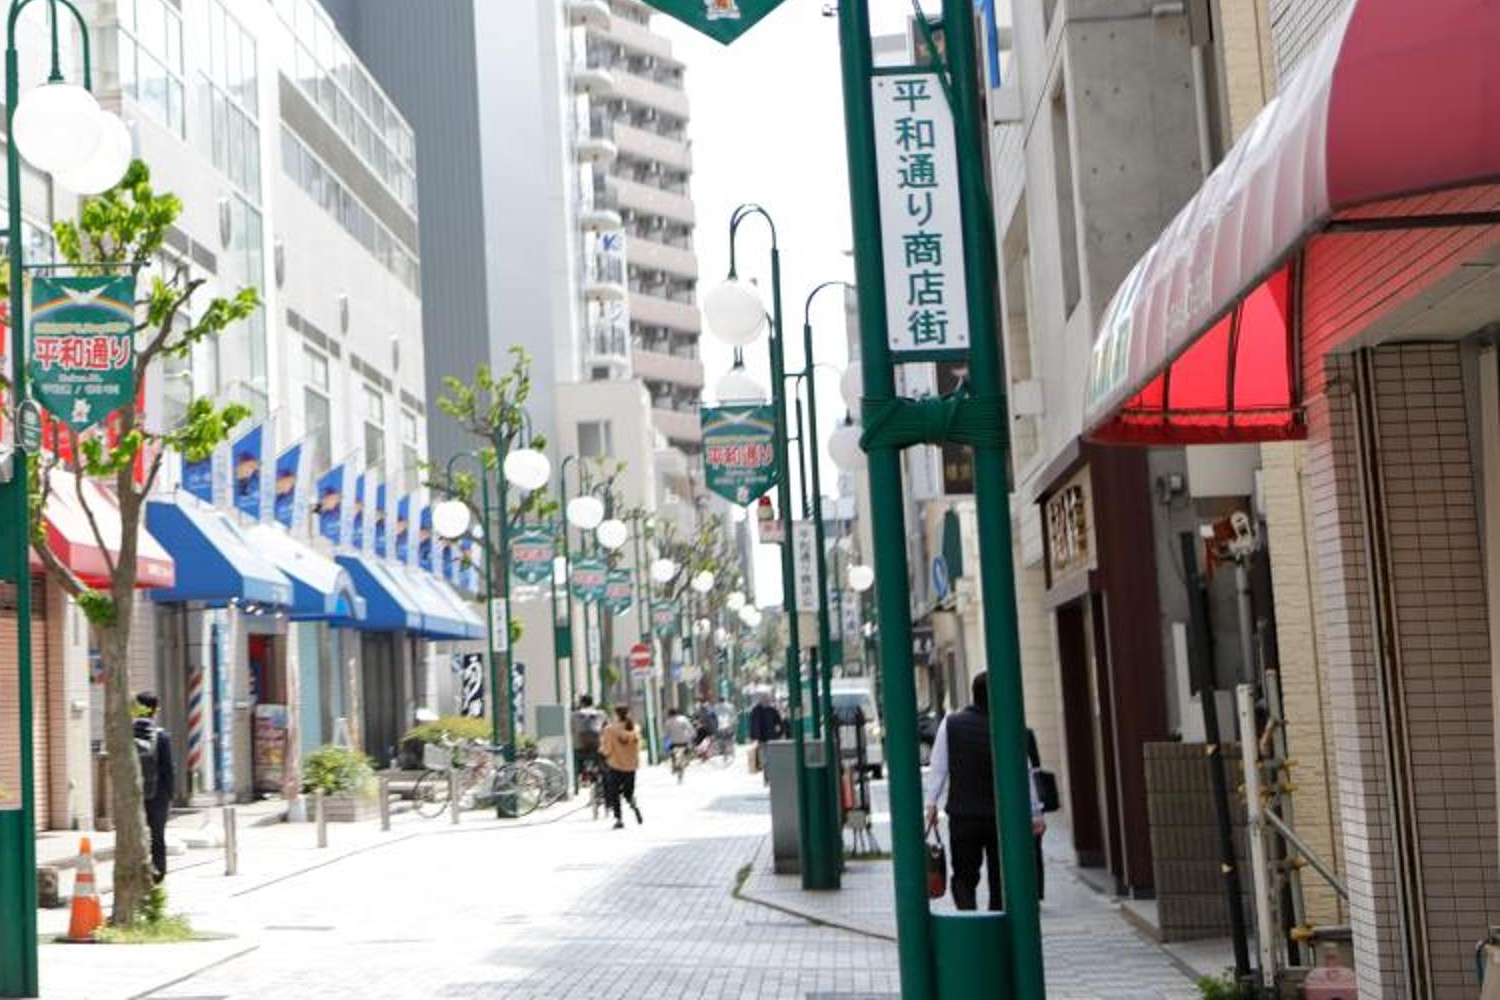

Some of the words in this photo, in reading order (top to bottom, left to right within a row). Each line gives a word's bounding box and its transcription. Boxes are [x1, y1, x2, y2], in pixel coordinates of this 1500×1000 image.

[892, 78, 949, 347] 平和通り商店街
[34, 335, 131, 371] 平和通り
